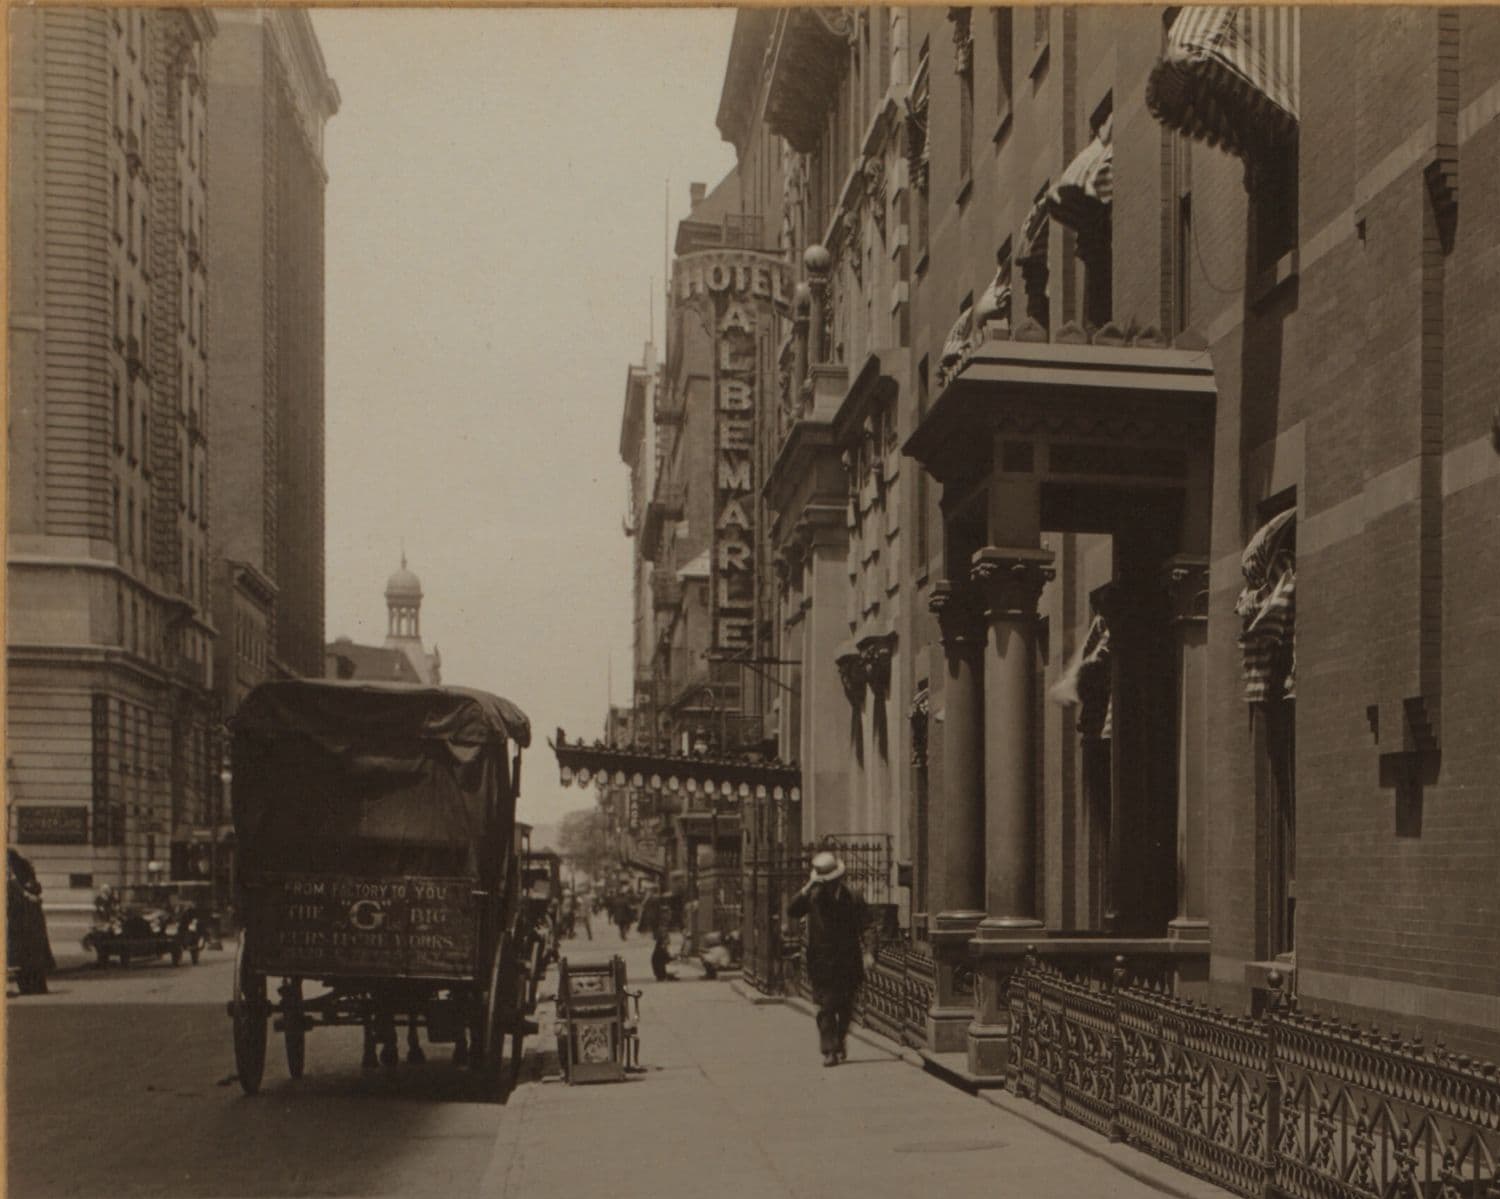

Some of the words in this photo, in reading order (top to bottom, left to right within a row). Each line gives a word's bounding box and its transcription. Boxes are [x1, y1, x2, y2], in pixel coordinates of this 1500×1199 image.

[682, 262, 787, 302] HOTEL
[717, 306, 755, 650] ALBEMARLE
[284, 882, 325, 897] FROM
[392, 886, 406, 898] TO
[415, 886, 448, 901] YOU
[410, 906, 448, 925] BIG
